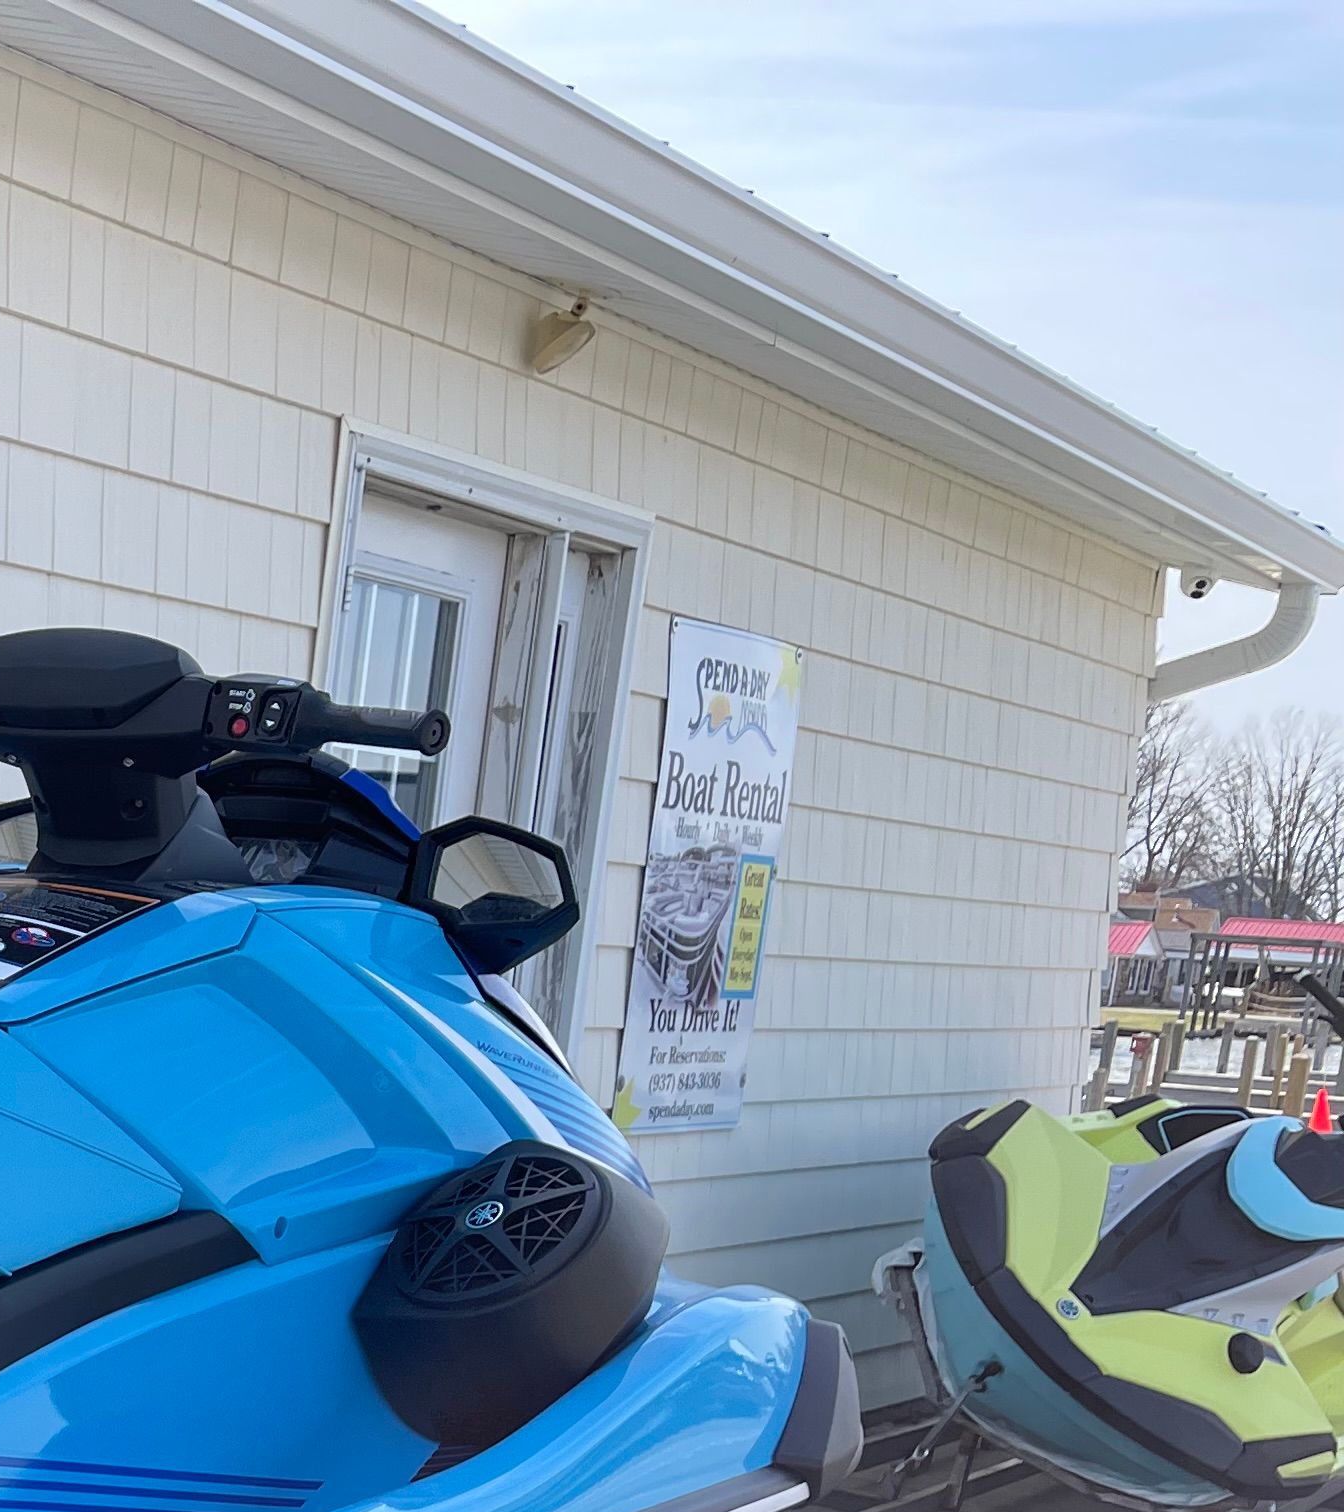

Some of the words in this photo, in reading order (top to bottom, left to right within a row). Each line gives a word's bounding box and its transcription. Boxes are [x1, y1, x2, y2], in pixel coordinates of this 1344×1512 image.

[662, 750, 718, 815] Boat
[720, 760, 787, 824] Rental
[744, 864, 765, 888] Great
[649, 998, 677, 1033] You
[680, 999, 720, 1033] Drive
[722, 999, 740, 1033] It!
[649, 1046, 667, 1065] For
[668, 1046, 726, 1064] Reservations:
[648, 1072, 676, 1095] (937)
[677, 1071, 722, 1091] 843-3036
[648, 1099, 714, 1122] spendaday.com
